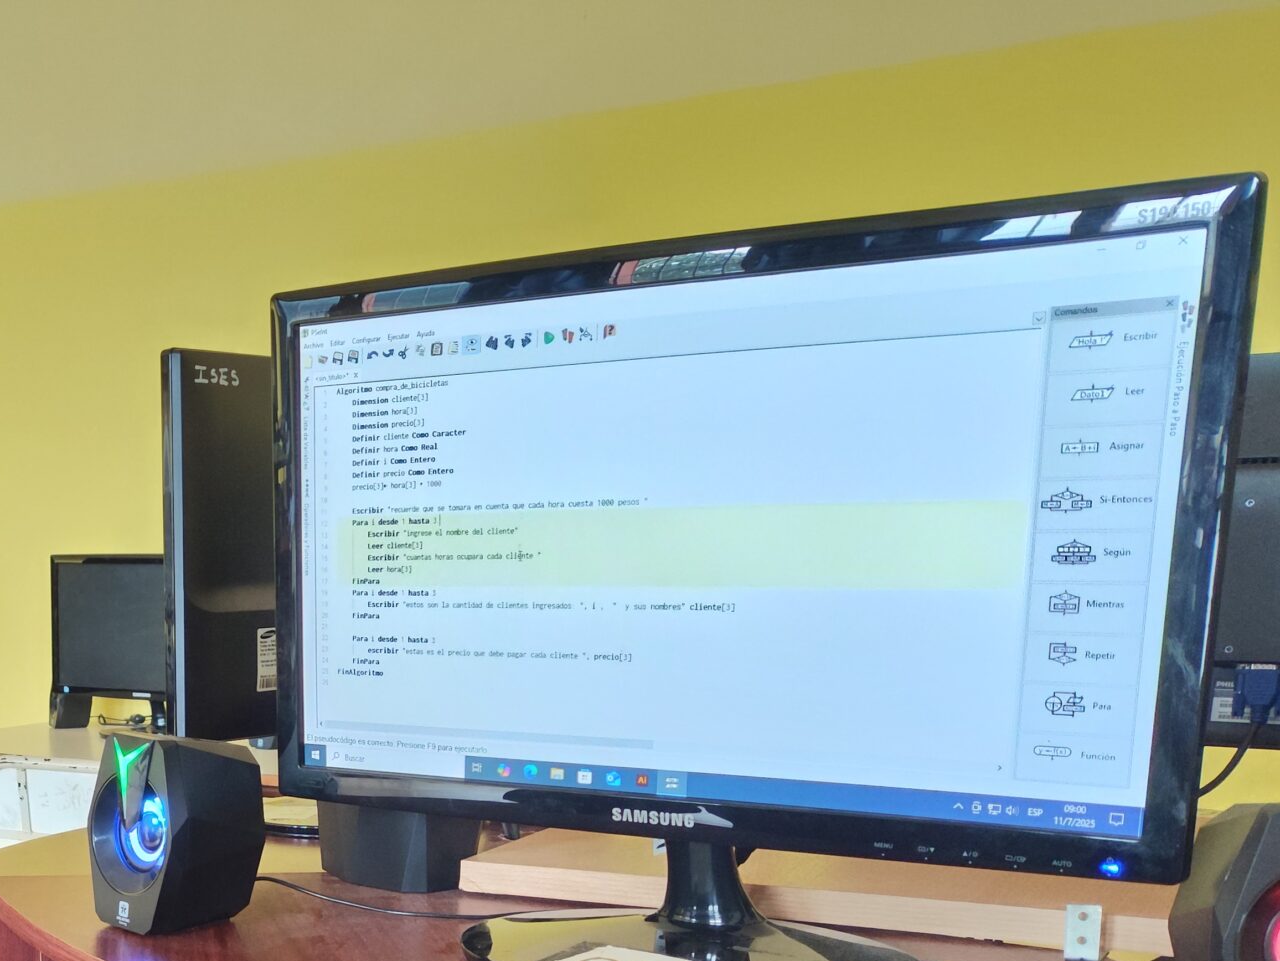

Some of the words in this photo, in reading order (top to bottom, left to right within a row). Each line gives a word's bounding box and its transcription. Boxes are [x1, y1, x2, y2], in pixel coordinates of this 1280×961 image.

[1054, 306, 1098, 316] Comandos
[330, 339, 345, 347] Editar
[352, 336, 381, 345] Configurar
[388, 333, 410, 342] Ejecutar
[417, 330, 435, 338] Ayuda
[1124, 333, 1158, 342] Escribir
[194, 364, 240, 387] ISES
[337, 385, 372, 396] Algoritmo
[375, 380, 448, 392] compra_de_bicicletas
[1126, 387, 1145, 395] Leer
[352, 398, 389, 406] Dimension
[352, 410, 389, 418] Dimension
[352, 422, 389, 430] Dimension
[352, 435, 380, 443] Definir
[384, 432, 409, 441] cliente
[412, 431, 429, 439] Como
[432, 429, 467, 437] Caracter
[352, 446, 380, 455] Definir
[421, 443, 438, 451] Real
[1109, 442, 1145, 452] Asignar
[352, 458, 380, 467] Definir
[352, 471, 380, 479] Definir
[383, 470, 405, 478] precio
[408, 468, 425, 476] Como
[1100, 495, 1153, 504] Si-Entonces
[352, 507, 384, 515] Escribir
[485, 502, 509, 511] cuenta
[528, 501, 545, 509] cada
[548, 499, 565, 508] hora
[568, 499, 594, 508] cuesta
[597, 499, 615, 507] 1000
[618, 499, 640, 507] pesos
[352, 518, 368, 526] Para
[409, 517, 430, 525] hasta
[368, 530, 400, 538] Escribir
[368, 542, 383, 550] Leer
[487, 552, 503, 560] cada
[506, 551, 534, 560] cliente
[1103, 548, 1131, 558] Según
[442, 601, 450, 609] la
[452, 601, 483, 609] cantidad
[498, 601, 529, 610] clientes
[689, 603, 736, 613] cliente[3]
[1086, 600, 1125, 609] Mientras
[368, 647, 399, 655] escribir
[448, 649, 470, 657] precio
[489, 650, 504, 658] debe
[507, 652, 527, 660] pagar
[530, 651, 547, 659] cada
[550, 651, 579, 660] cliente
[594, 653, 633, 662] precio[3]
[1085, 651, 1115, 661] Repetir
[338, 669, 384, 677] FinAlgoritmo
[1093, 702, 1111, 711] Para
[314, 735, 357, 745] pseudocódigo
[397, 741, 426, 750] Presione
[438, 744, 452, 752] para
[345, 754, 365, 762] Buscar
[1081, 751, 1116, 761] Función
[638, 776, 647, 785] Ai
[1028, 807, 1044, 817] ESP
[1064, 804, 1087, 815] 09:00
[612, 807, 695, 828] SAMSUNG
[1053, 816, 1096, 829] 11/7/2025
[874, 842, 893, 850] MENU
[1052, 859, 1072, 868] AUTO
